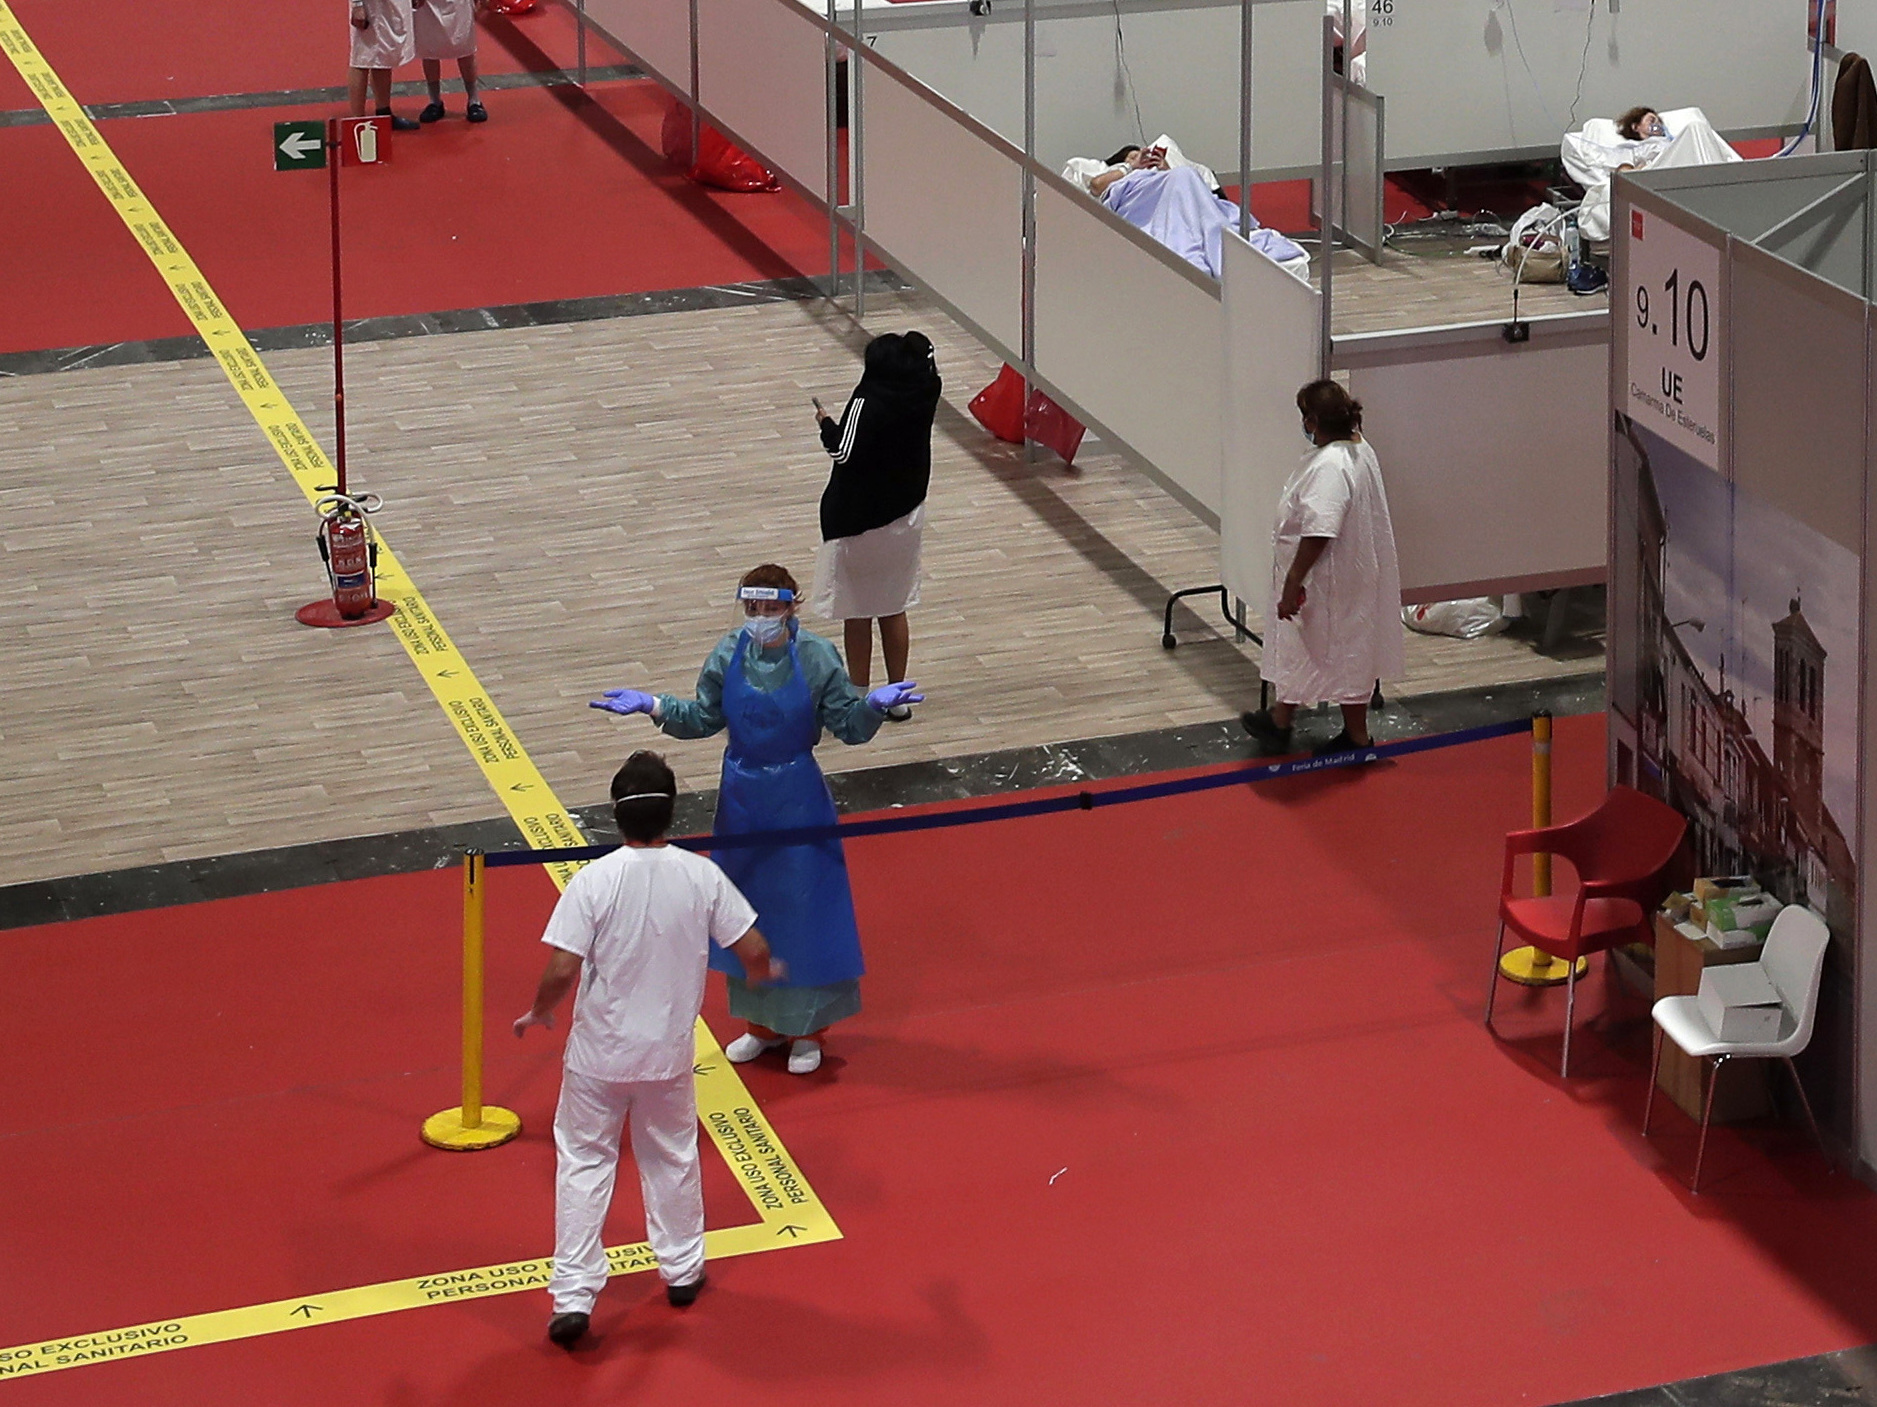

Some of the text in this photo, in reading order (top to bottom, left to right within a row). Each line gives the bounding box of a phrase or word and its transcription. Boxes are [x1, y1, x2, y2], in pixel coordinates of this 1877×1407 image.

[1372, 17, 1393, 27] 9.10
[1637, 267, 1710, 362] 9.10
[1662, 366, 1684, 405] UE
[402, 596, 449, 652] PERSONAL SANITARIO
[410, 640, 430, 655] ZONA
[448, 700, 500, 764] ZONA USO EXCLUSIVO
[469, 697, 520, 760] PERSONAL SANITARIO
[1292, 753, 1356, 773] Feria de Madrid
[708, 1111, 785, 1210] ZONA USO EXCLUSIVO
[733, 1106, 810, 1205] PERSONAL SANITARIO
[416, 1272, 484, 1290] ZONA
[489, 1263, 538, 1279] USO
[426, 1274, 552, 1300] PERSONAL
[0, 1323, 182, 1362] SO EXCLUSIVO
[56, 1334, 189, 1365] SANITARIO
